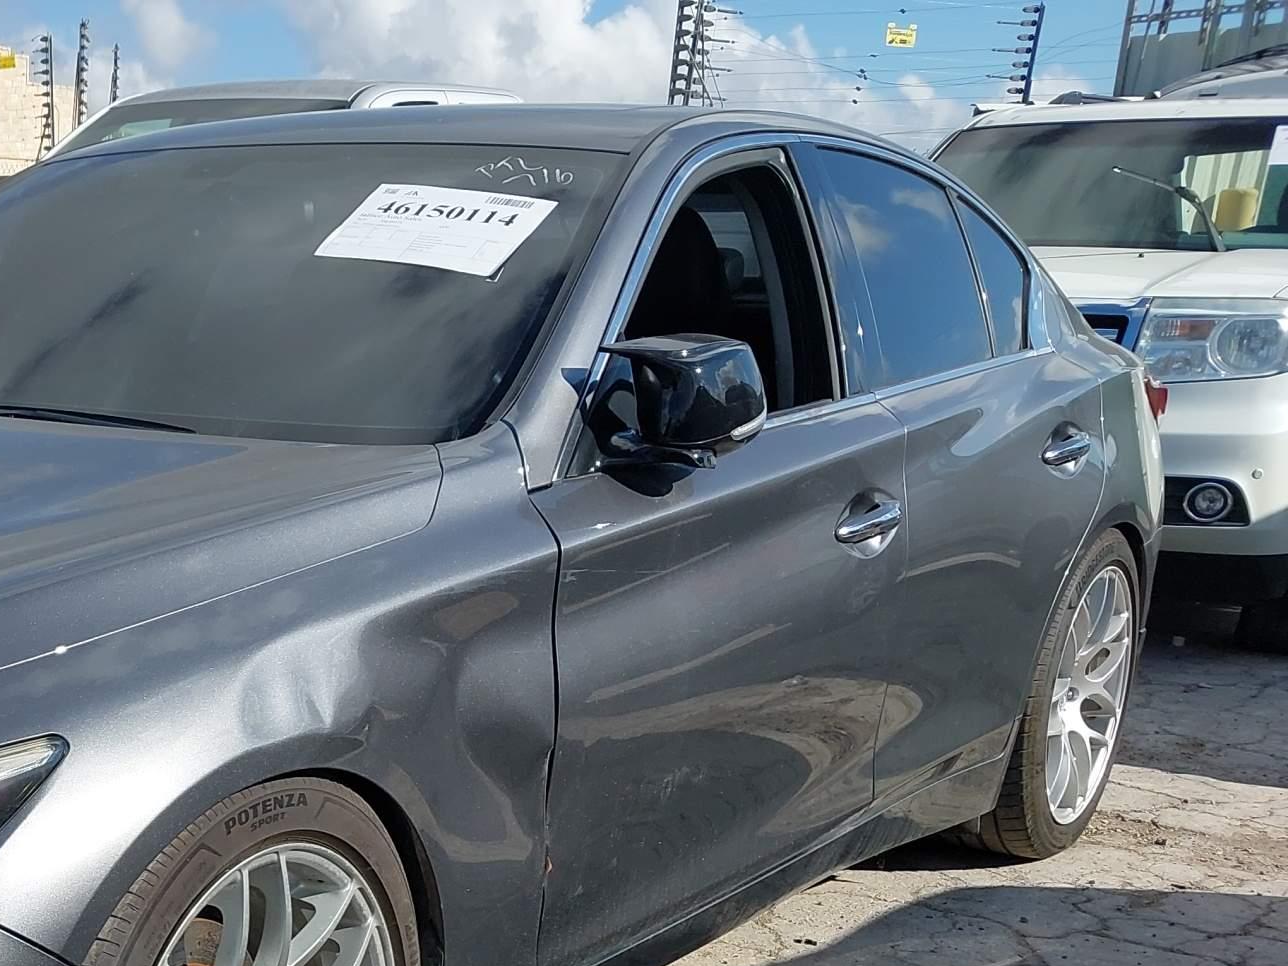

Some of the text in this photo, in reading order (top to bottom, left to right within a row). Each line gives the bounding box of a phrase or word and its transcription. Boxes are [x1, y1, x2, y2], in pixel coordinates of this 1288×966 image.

[377, 200, 520, 227] 46150114
[223, 792, 309, 836] POTENZA
[250, 811, 287, 832] SPORT
